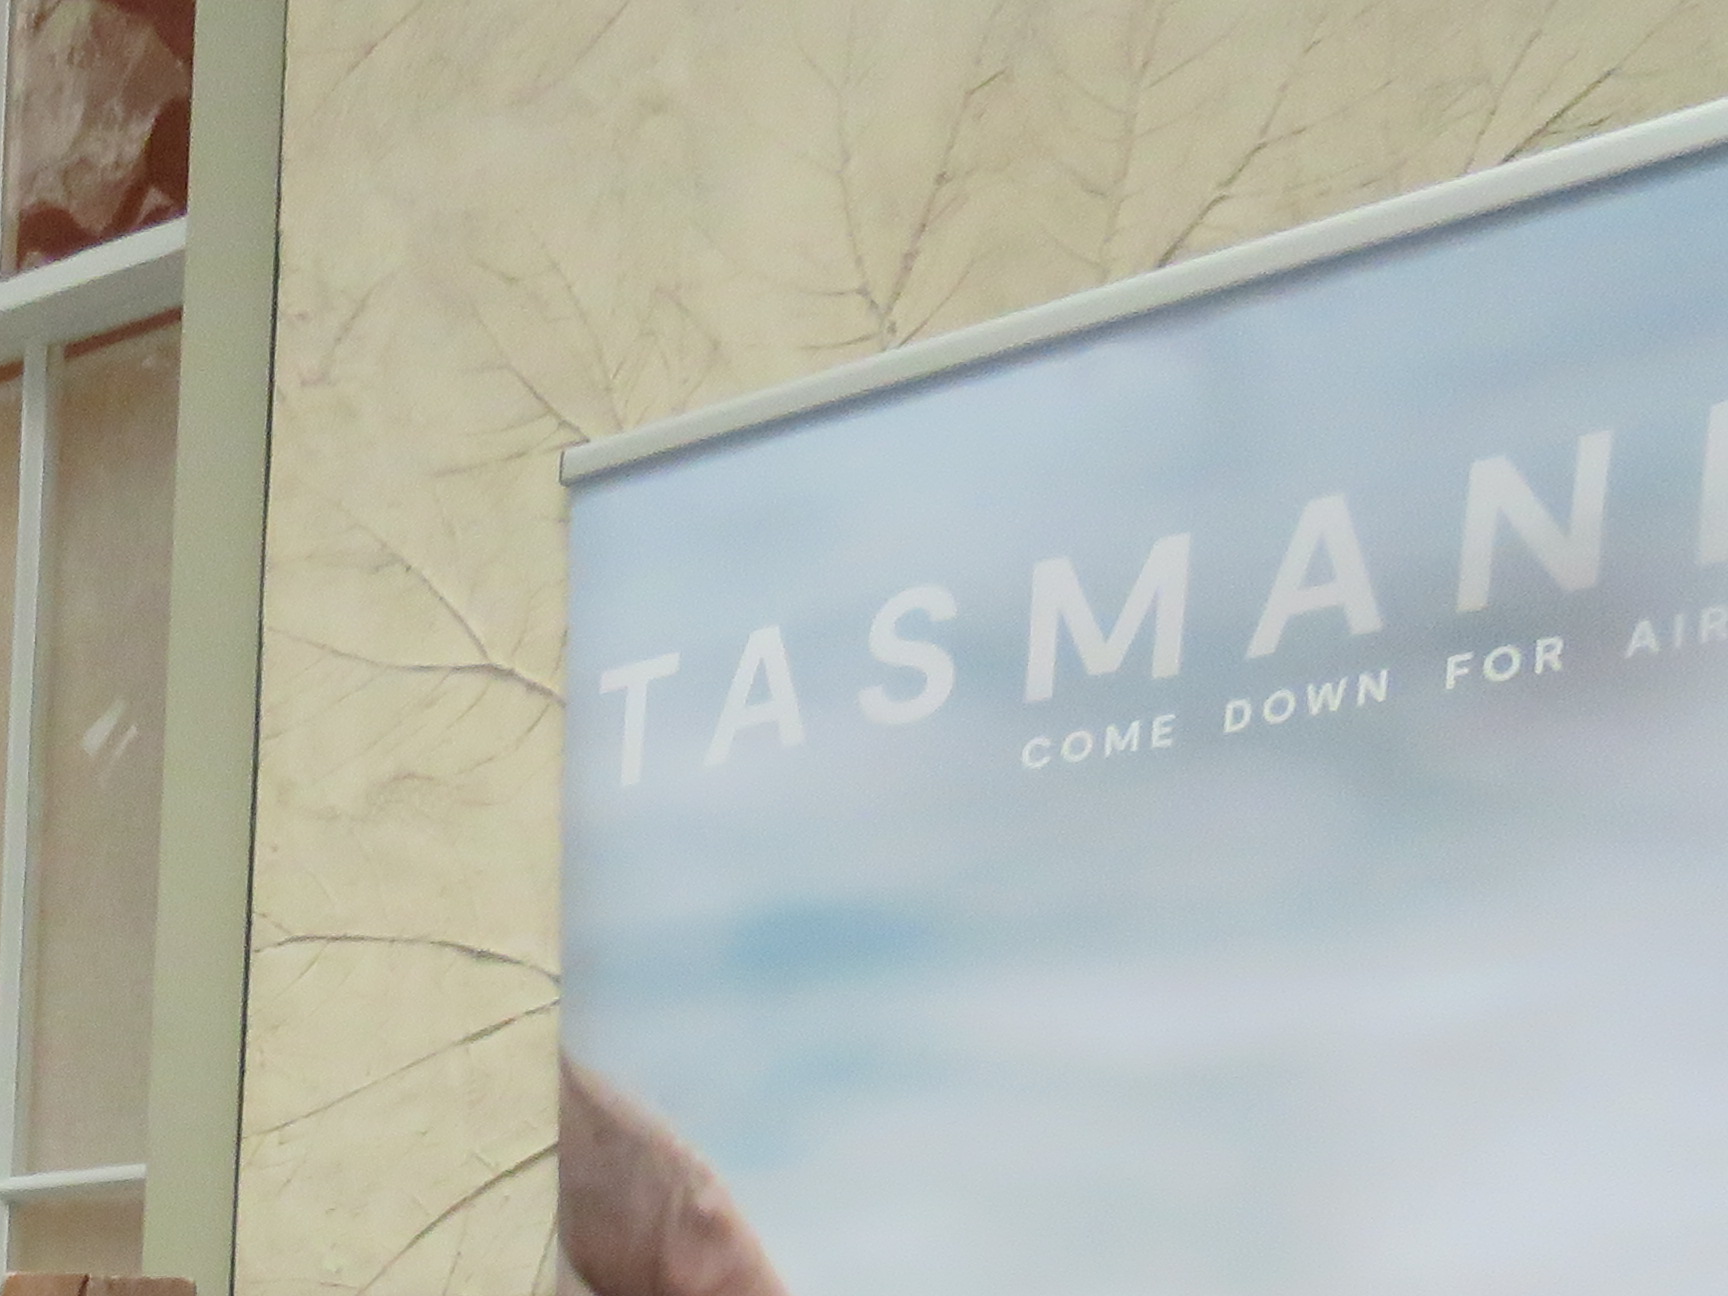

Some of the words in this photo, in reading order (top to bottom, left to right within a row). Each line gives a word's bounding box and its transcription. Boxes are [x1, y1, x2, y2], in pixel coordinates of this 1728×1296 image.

[1022, 715, 1176, 770] COME
[1224, 670, 1390, 733] DOWN
[1446, 636, 1564, 690] FOR
[1626, 604, 1728, 659] AIR
